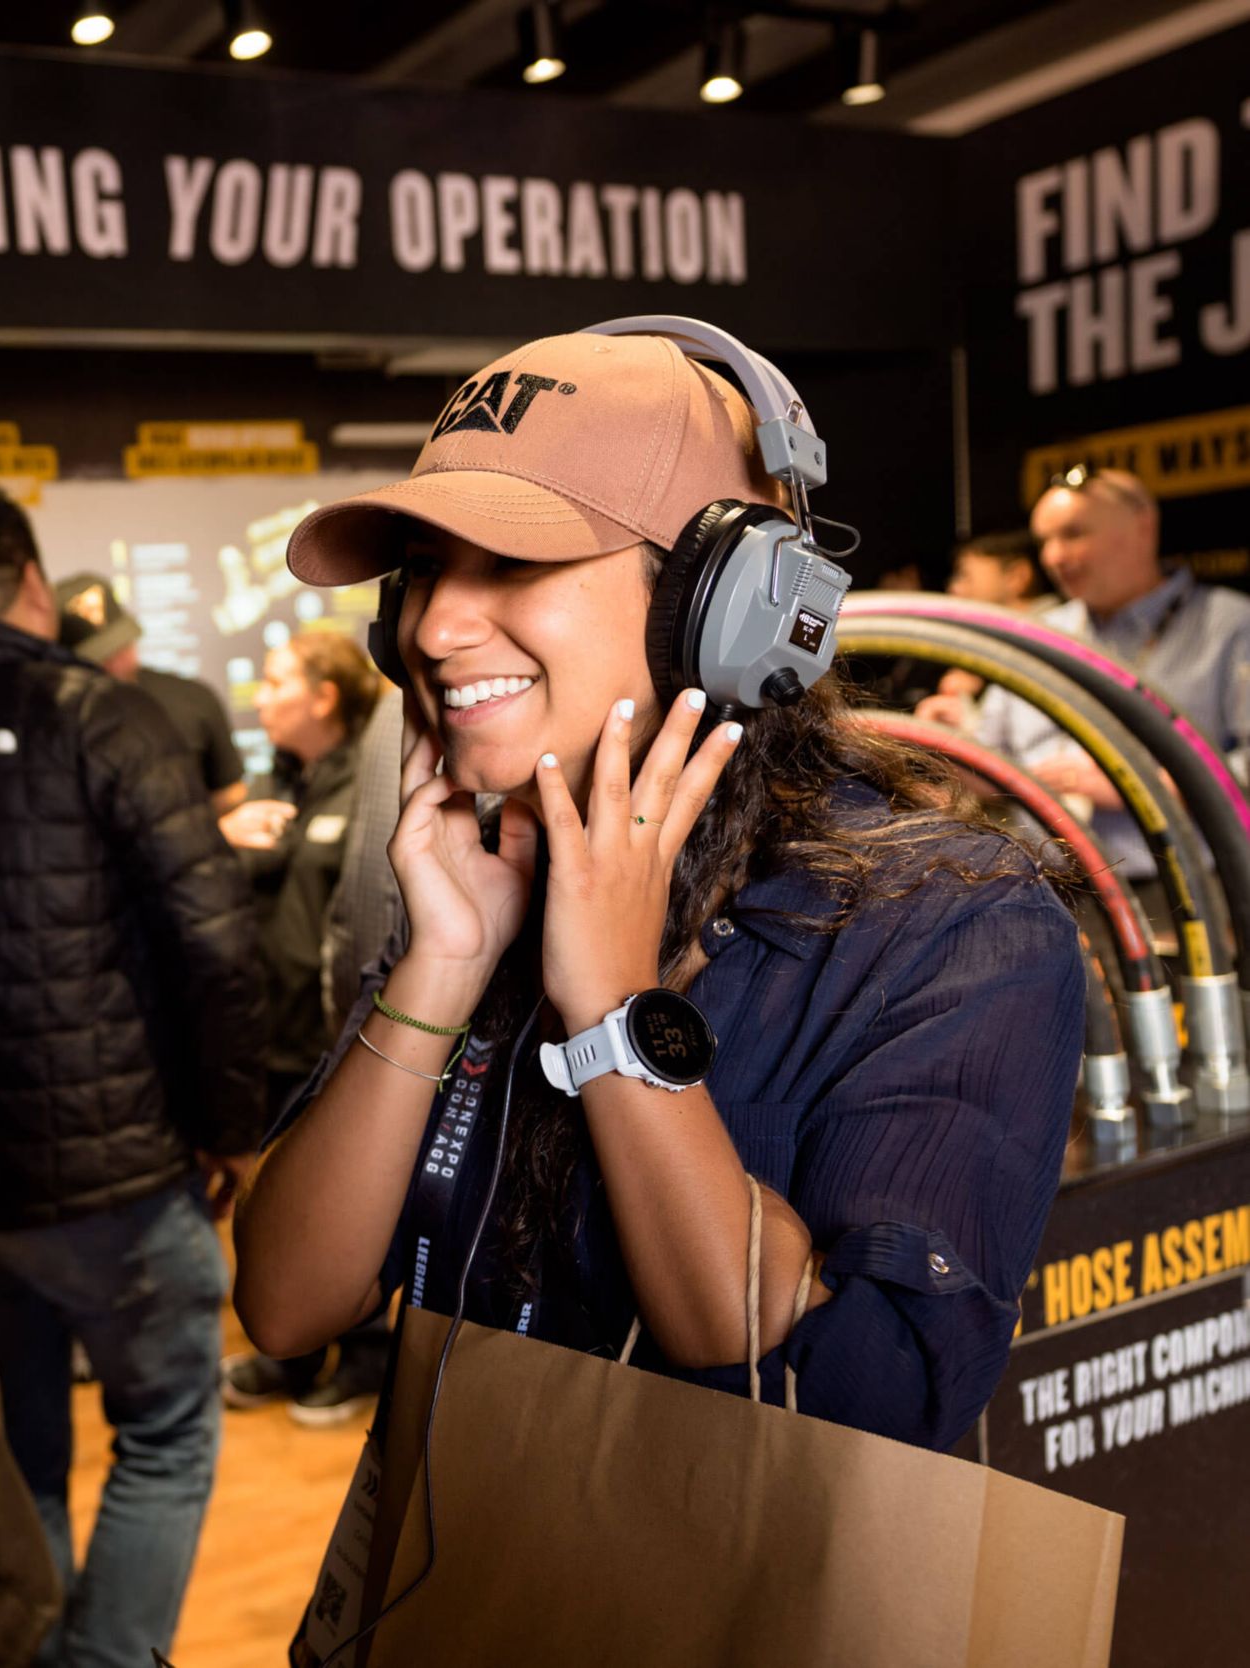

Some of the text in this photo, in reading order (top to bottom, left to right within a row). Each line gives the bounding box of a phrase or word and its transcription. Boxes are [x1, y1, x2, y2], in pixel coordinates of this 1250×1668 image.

[164, 154, 362, 269] YOUR
[389, 168, 746, 286] OPERATION
[1015, 117, 1220, 284] FIND
[1015, 249, 1181, 394] THE
[664, 1027, 688, 1058] 33
[441, 1082, 481, 1178] CONEXPO
[1043, 1240, 1136, 1326] HOSE
[1140, 1204, 1250, 1297] ASSEM
[1019, 1367, 1071, 1426] THE
[1073, 1340, 1149, 1409] RIGHT
[1044, 1415, 1096, 1473] FOR
[1101, 1388, 1166, 1452] YOUR
